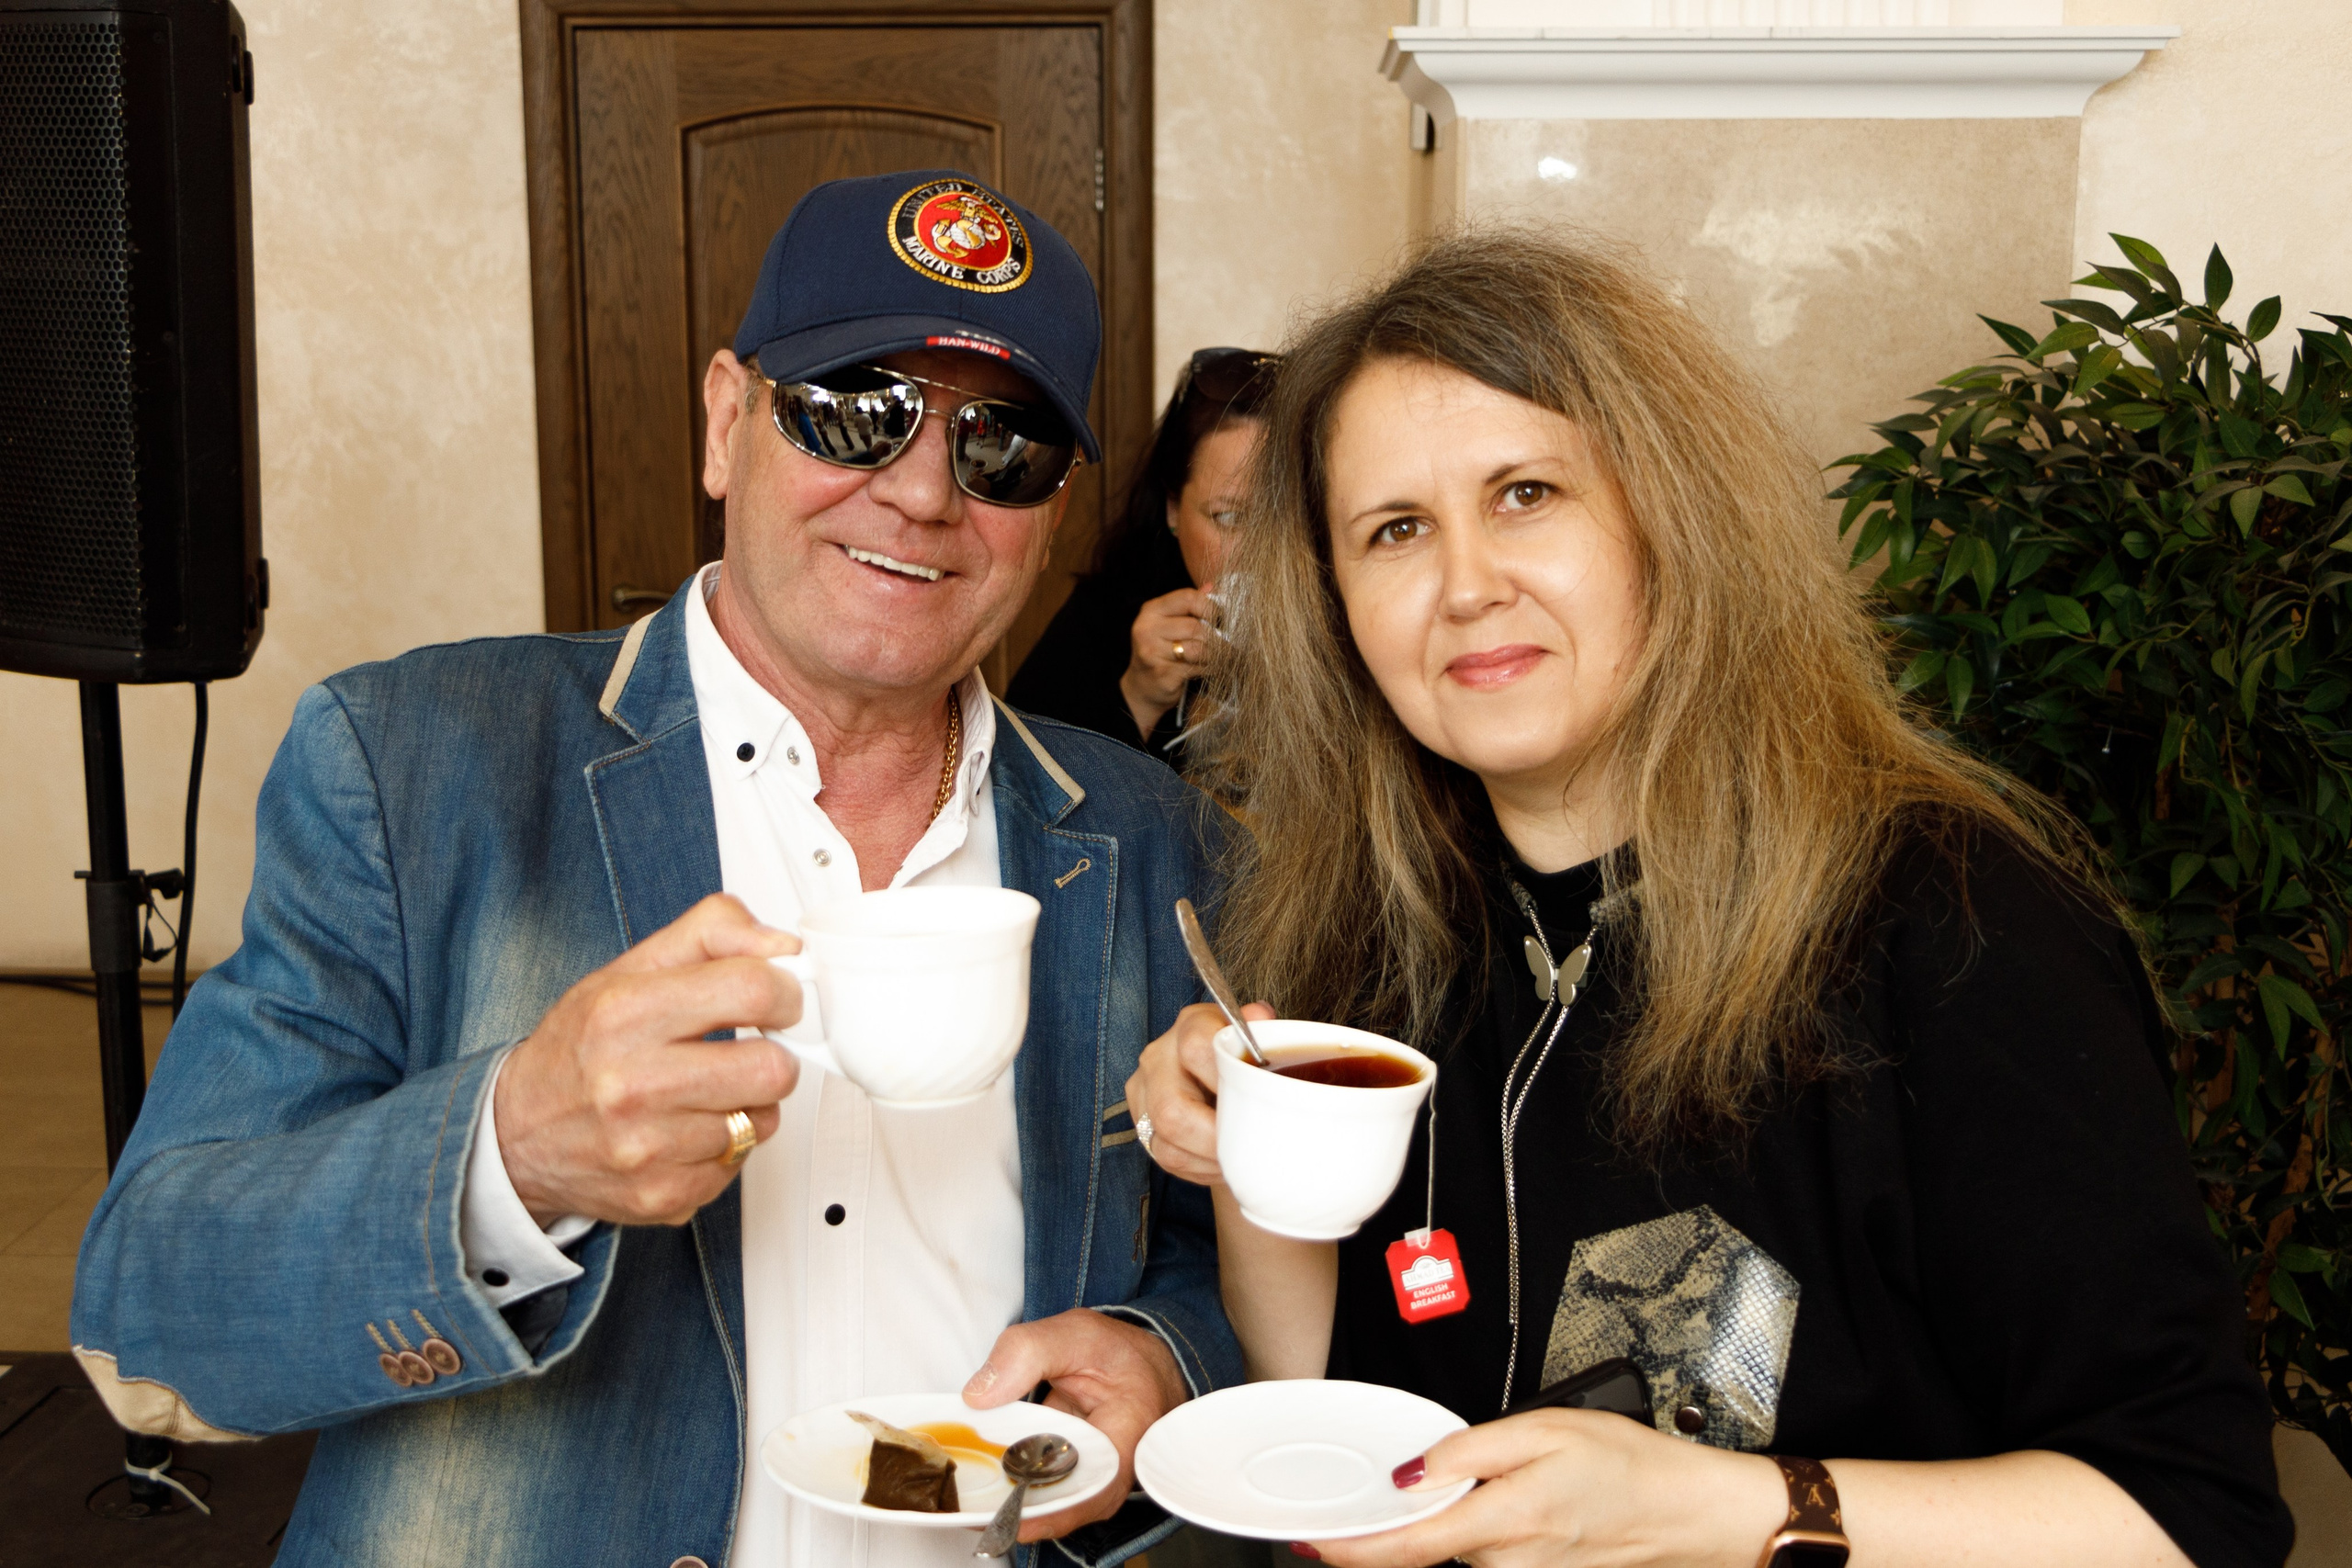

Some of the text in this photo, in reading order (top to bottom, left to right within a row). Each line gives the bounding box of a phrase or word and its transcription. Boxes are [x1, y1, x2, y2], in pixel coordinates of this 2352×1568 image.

[902, 183, 1023, 248] UNITED STATES
[902, 235, 1021, 284] MARINE CORPS
[1410, 1291, 1455, 1310] BREAKFAST
[1413, 1282, 1449, 1299] ENGLISH
